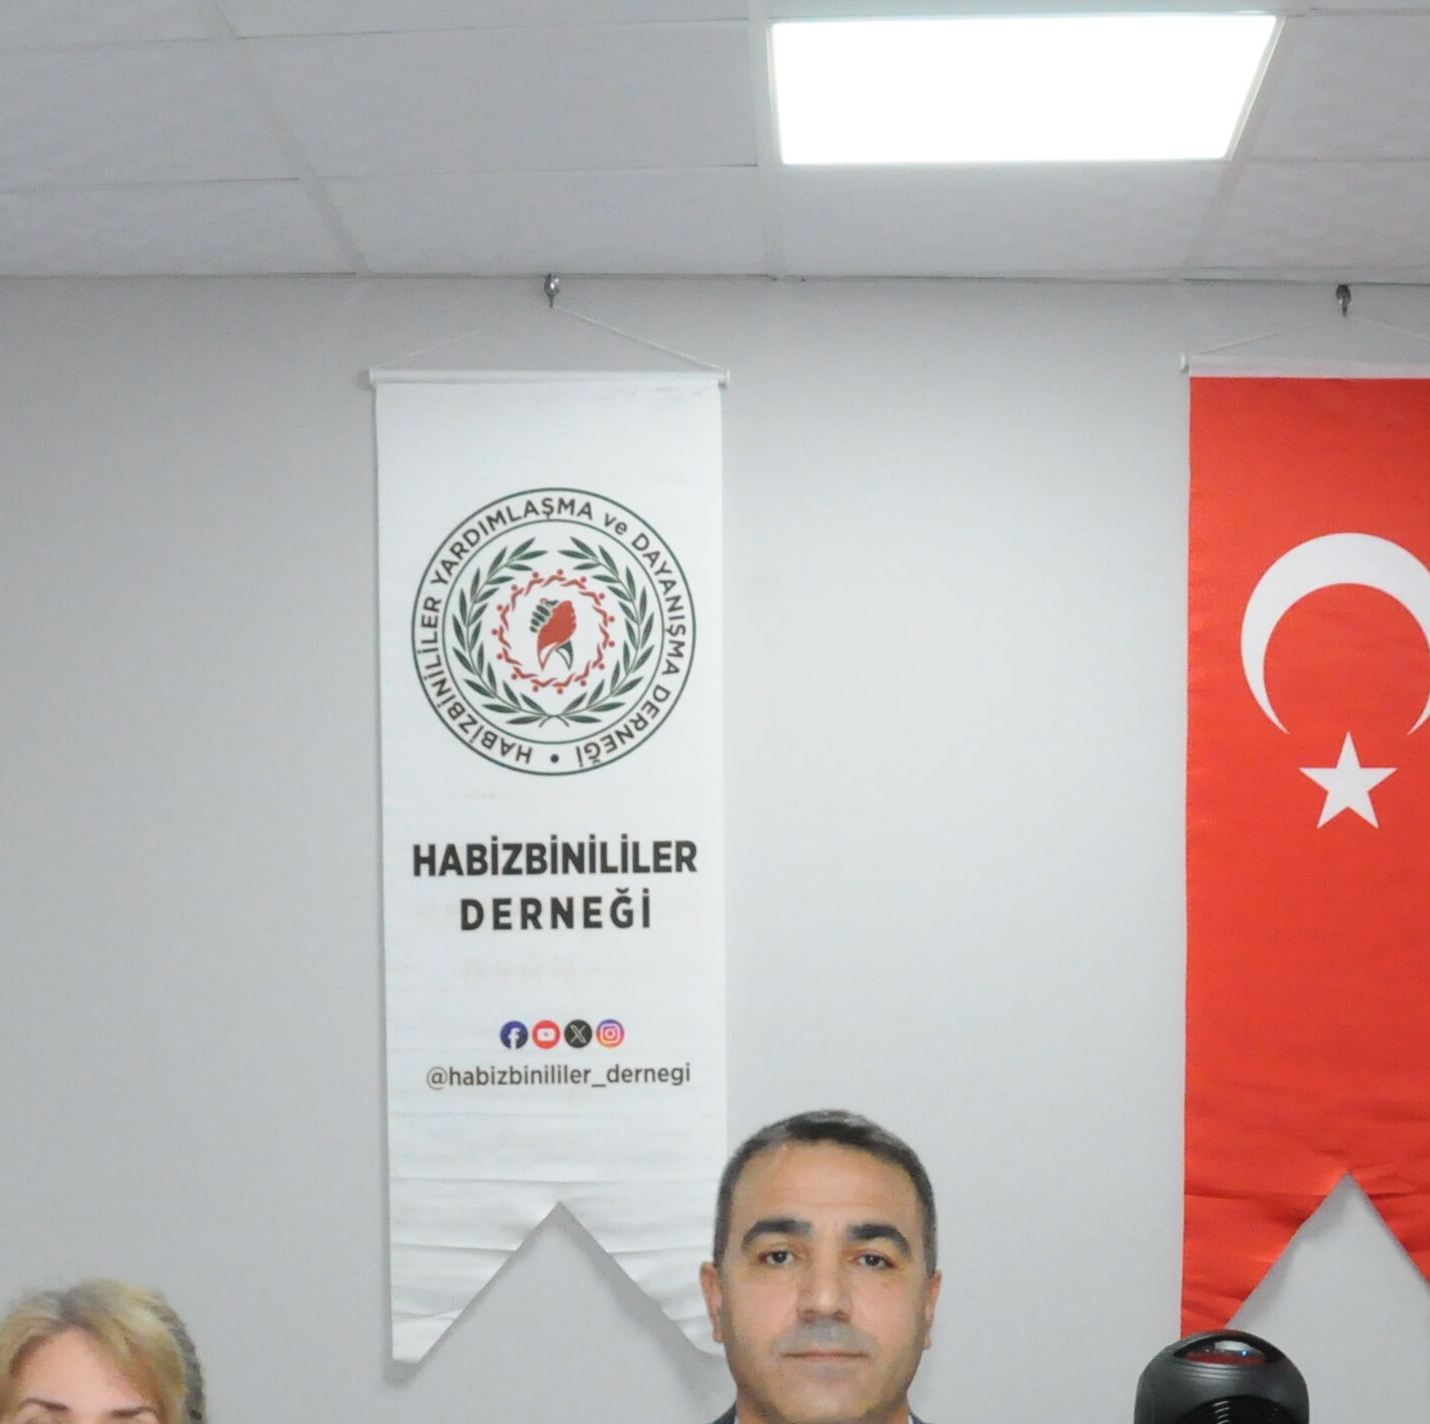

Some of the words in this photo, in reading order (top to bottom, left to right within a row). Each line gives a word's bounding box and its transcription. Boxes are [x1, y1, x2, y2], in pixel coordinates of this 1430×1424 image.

[431, 497, 593, 587] YARDIMLAŞMA
[603, 512, 629, 535] ve
[631, 531, 687, 677] DAYANIŞMA
[418, 595, 533, 765] HABİZBİNİLİLER
[575, 684, 671, 768] DERNEĞİ
[412, 834, 698, 877] HABİZBİNİLİLER
[460, 888, 651, 931] DERNEĞİ
[426, 1062, 691, 1091] @habizbinililer_dernegi
